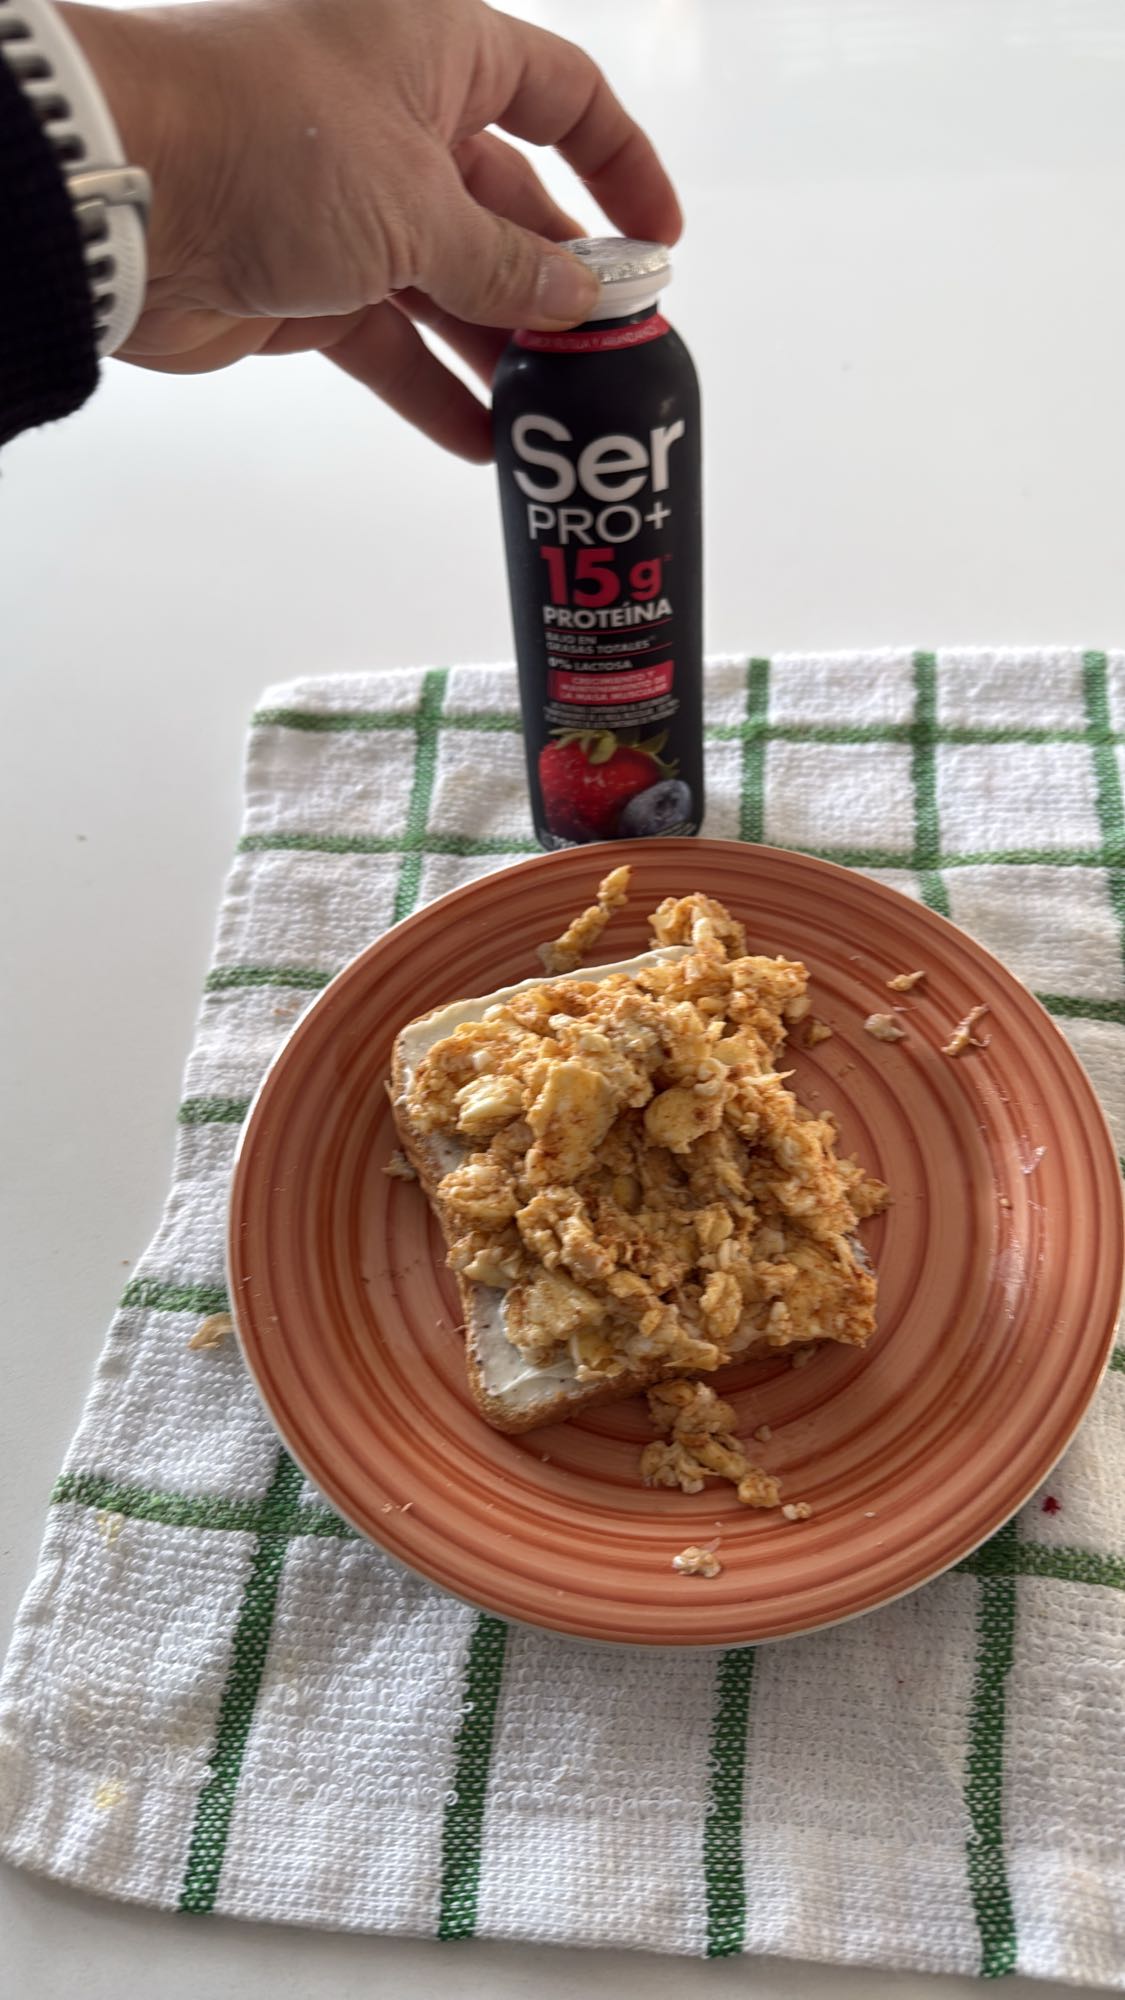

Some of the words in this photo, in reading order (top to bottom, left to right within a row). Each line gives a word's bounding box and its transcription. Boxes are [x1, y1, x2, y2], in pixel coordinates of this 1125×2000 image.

[511, 414, 685, 503] Ser
[527, 501, 671, 545] PRO+
[540, 546, 621, 608] 15
[543, 598, 673, 629] PROTEÍNA
[546, 642, 595, 655] GRASAS
[596, 640, 651, 654] TOTALES
[578, 635, 598, 645] EN
[547, 656, 573, 670] 0%
[574, 660, 633, 672] LACTOSA
